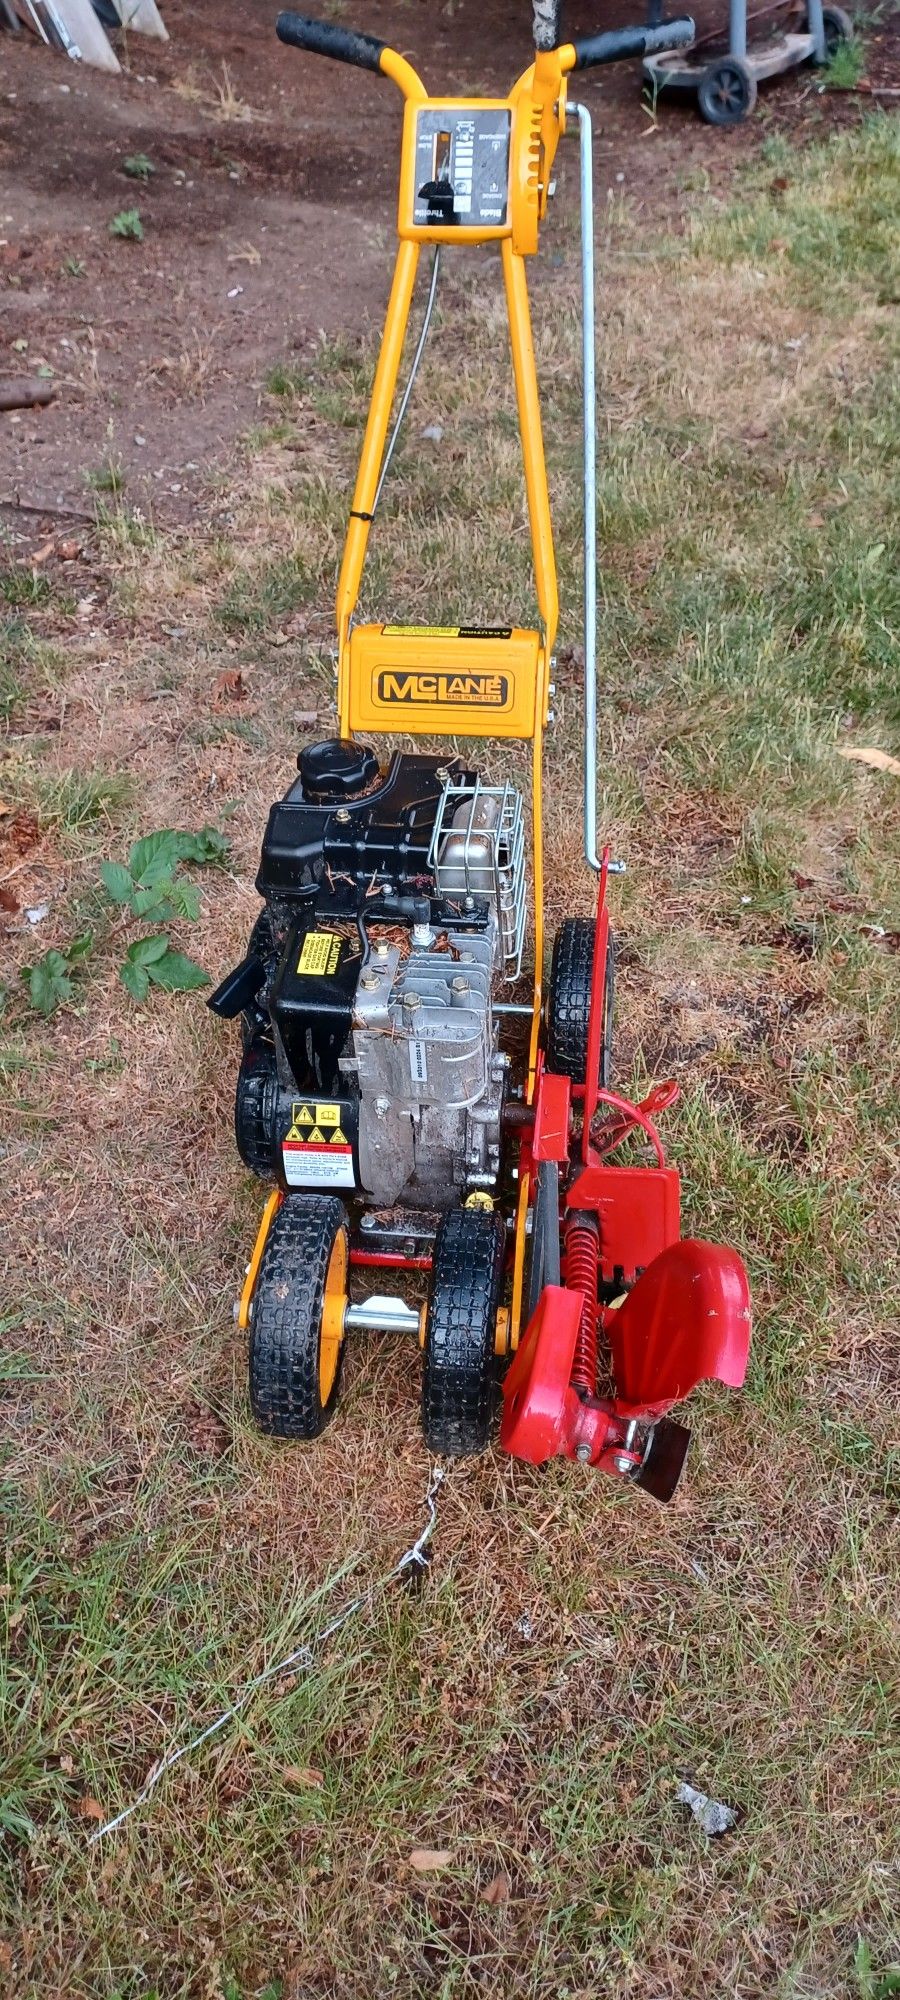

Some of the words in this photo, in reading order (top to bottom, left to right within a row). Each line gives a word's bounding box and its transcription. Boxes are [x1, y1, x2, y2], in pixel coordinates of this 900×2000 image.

[414, 209, 444, 218] Throttle
[480, 208, 502, 217] Blade
[326, 942, 341, 975] CAUTION
